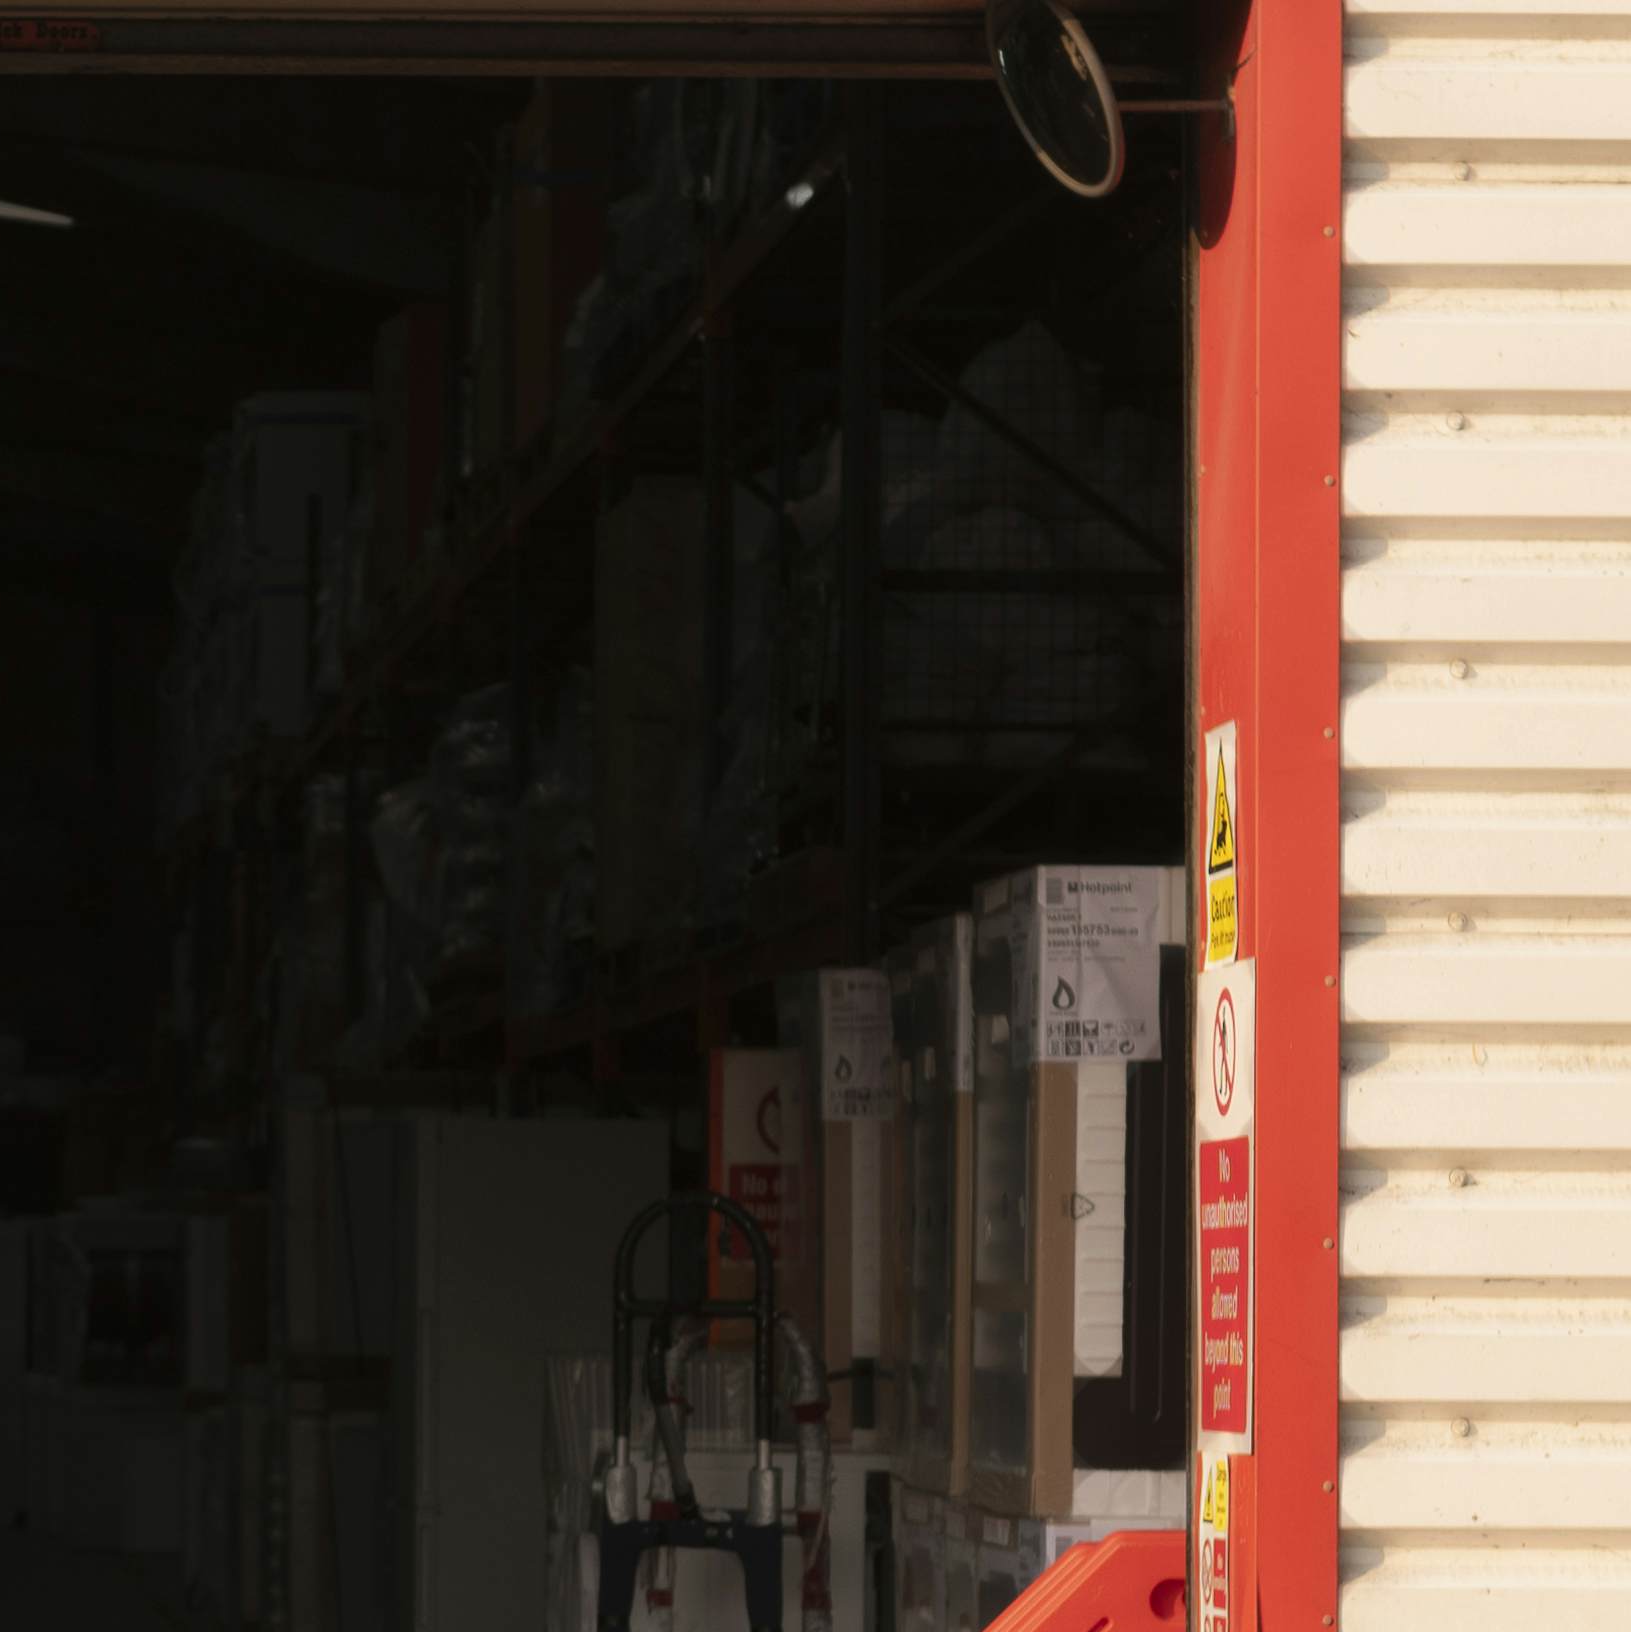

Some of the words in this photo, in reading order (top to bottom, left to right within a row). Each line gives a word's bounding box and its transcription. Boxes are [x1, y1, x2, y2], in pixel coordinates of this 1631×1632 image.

[1081, 882, 1132, 894] Hotpoint
[1218, 1149, 1230, 1183] No
[1201, 1193, 1248, 1230] unauthorised
[1210, 1246, 1240, 1281] persons
[1211, 1286, 1238, 1320] allowed
[1205, 1332, 1229, 1374] beyond
[1229, 1332, 1244, 1367] this
[1213, 1377, 1231, 1419] point
